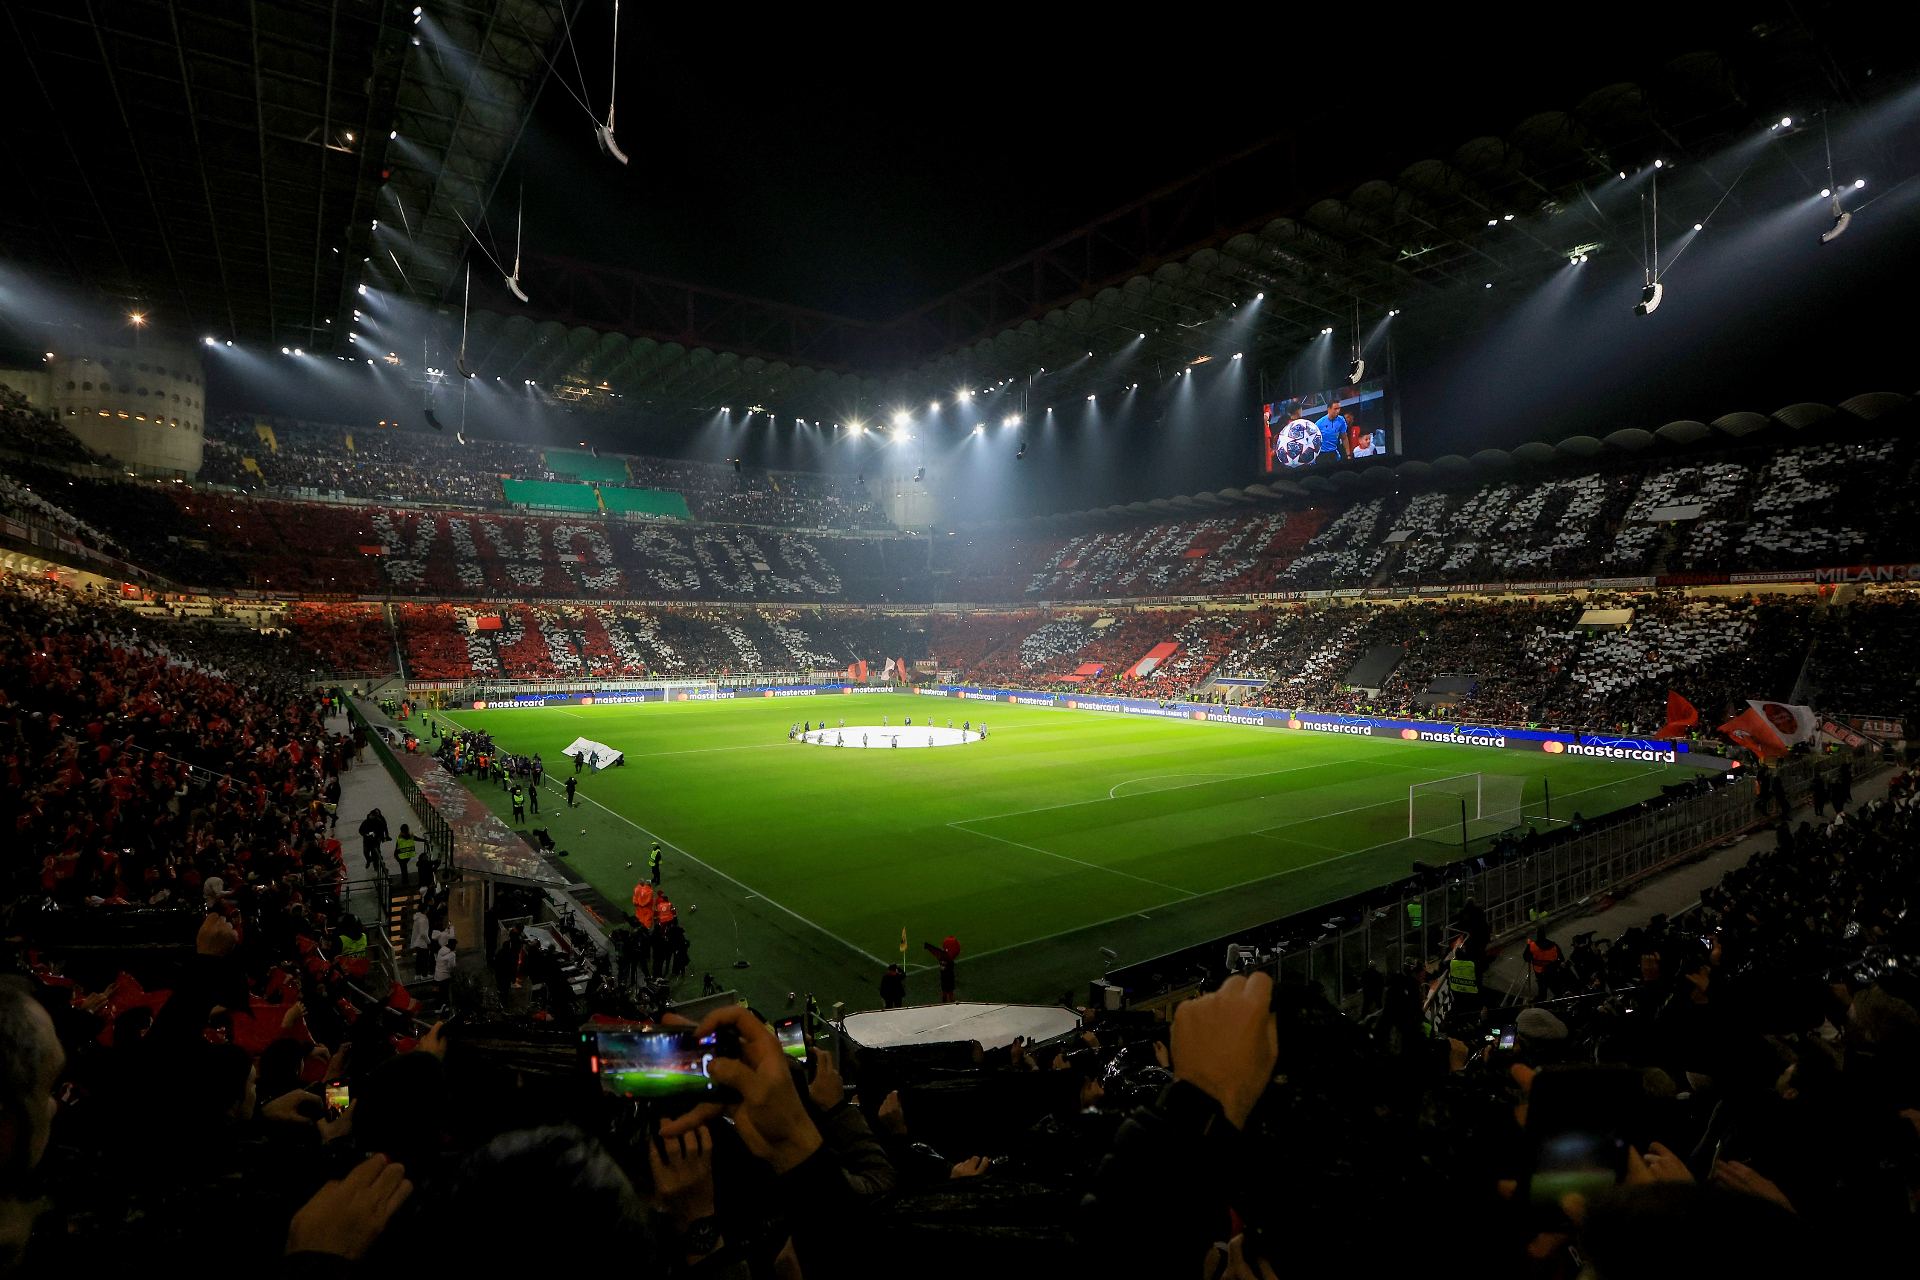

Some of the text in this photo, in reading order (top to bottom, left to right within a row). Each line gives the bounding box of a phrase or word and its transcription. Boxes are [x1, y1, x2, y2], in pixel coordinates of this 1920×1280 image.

[1815, 566, 1893, 583] MILAN
[775, 688, 816, 697] mastercard
[852, 686, 893, 694] mastercard
[920, 688, 948, 697] mastercard
[488, 699, 544, 709] mastercard
[595, 694, 645, 704] mastercard
[1017, 696, 1053, 707] mastercard
[1078, 701, 1120, 713] mastercard
[1207, 712, 1264, 727] mastercard
[1303, 720, 1371, 736] mastercard
[1862, 720, 1904, 734] ALBA
[1420, 730, 1505, 749] mastercard
[1567, 743, 1676, 764] mastercard
